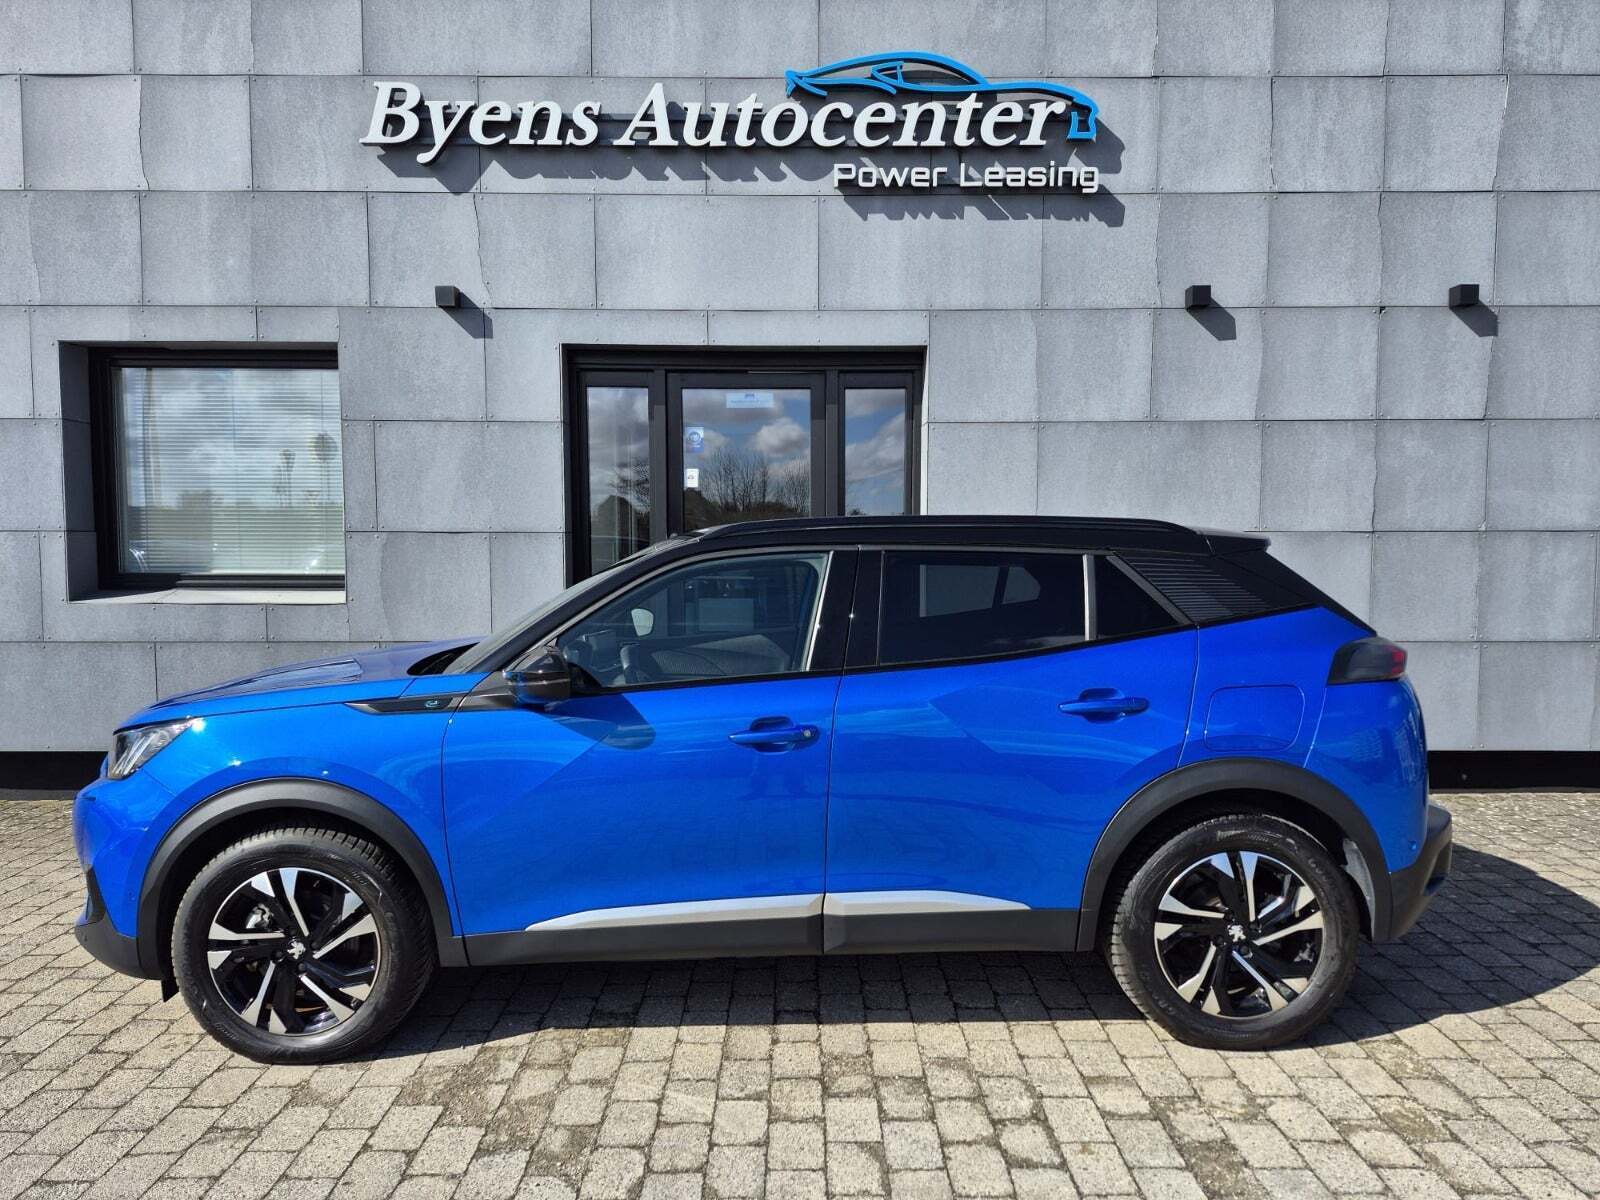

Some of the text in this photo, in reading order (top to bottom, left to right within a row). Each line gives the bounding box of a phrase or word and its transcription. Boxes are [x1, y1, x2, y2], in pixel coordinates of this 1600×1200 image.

[359, 81, 1067, 165] Byens Autocenter
[833, 161, 1100, 194] Power Leasing
